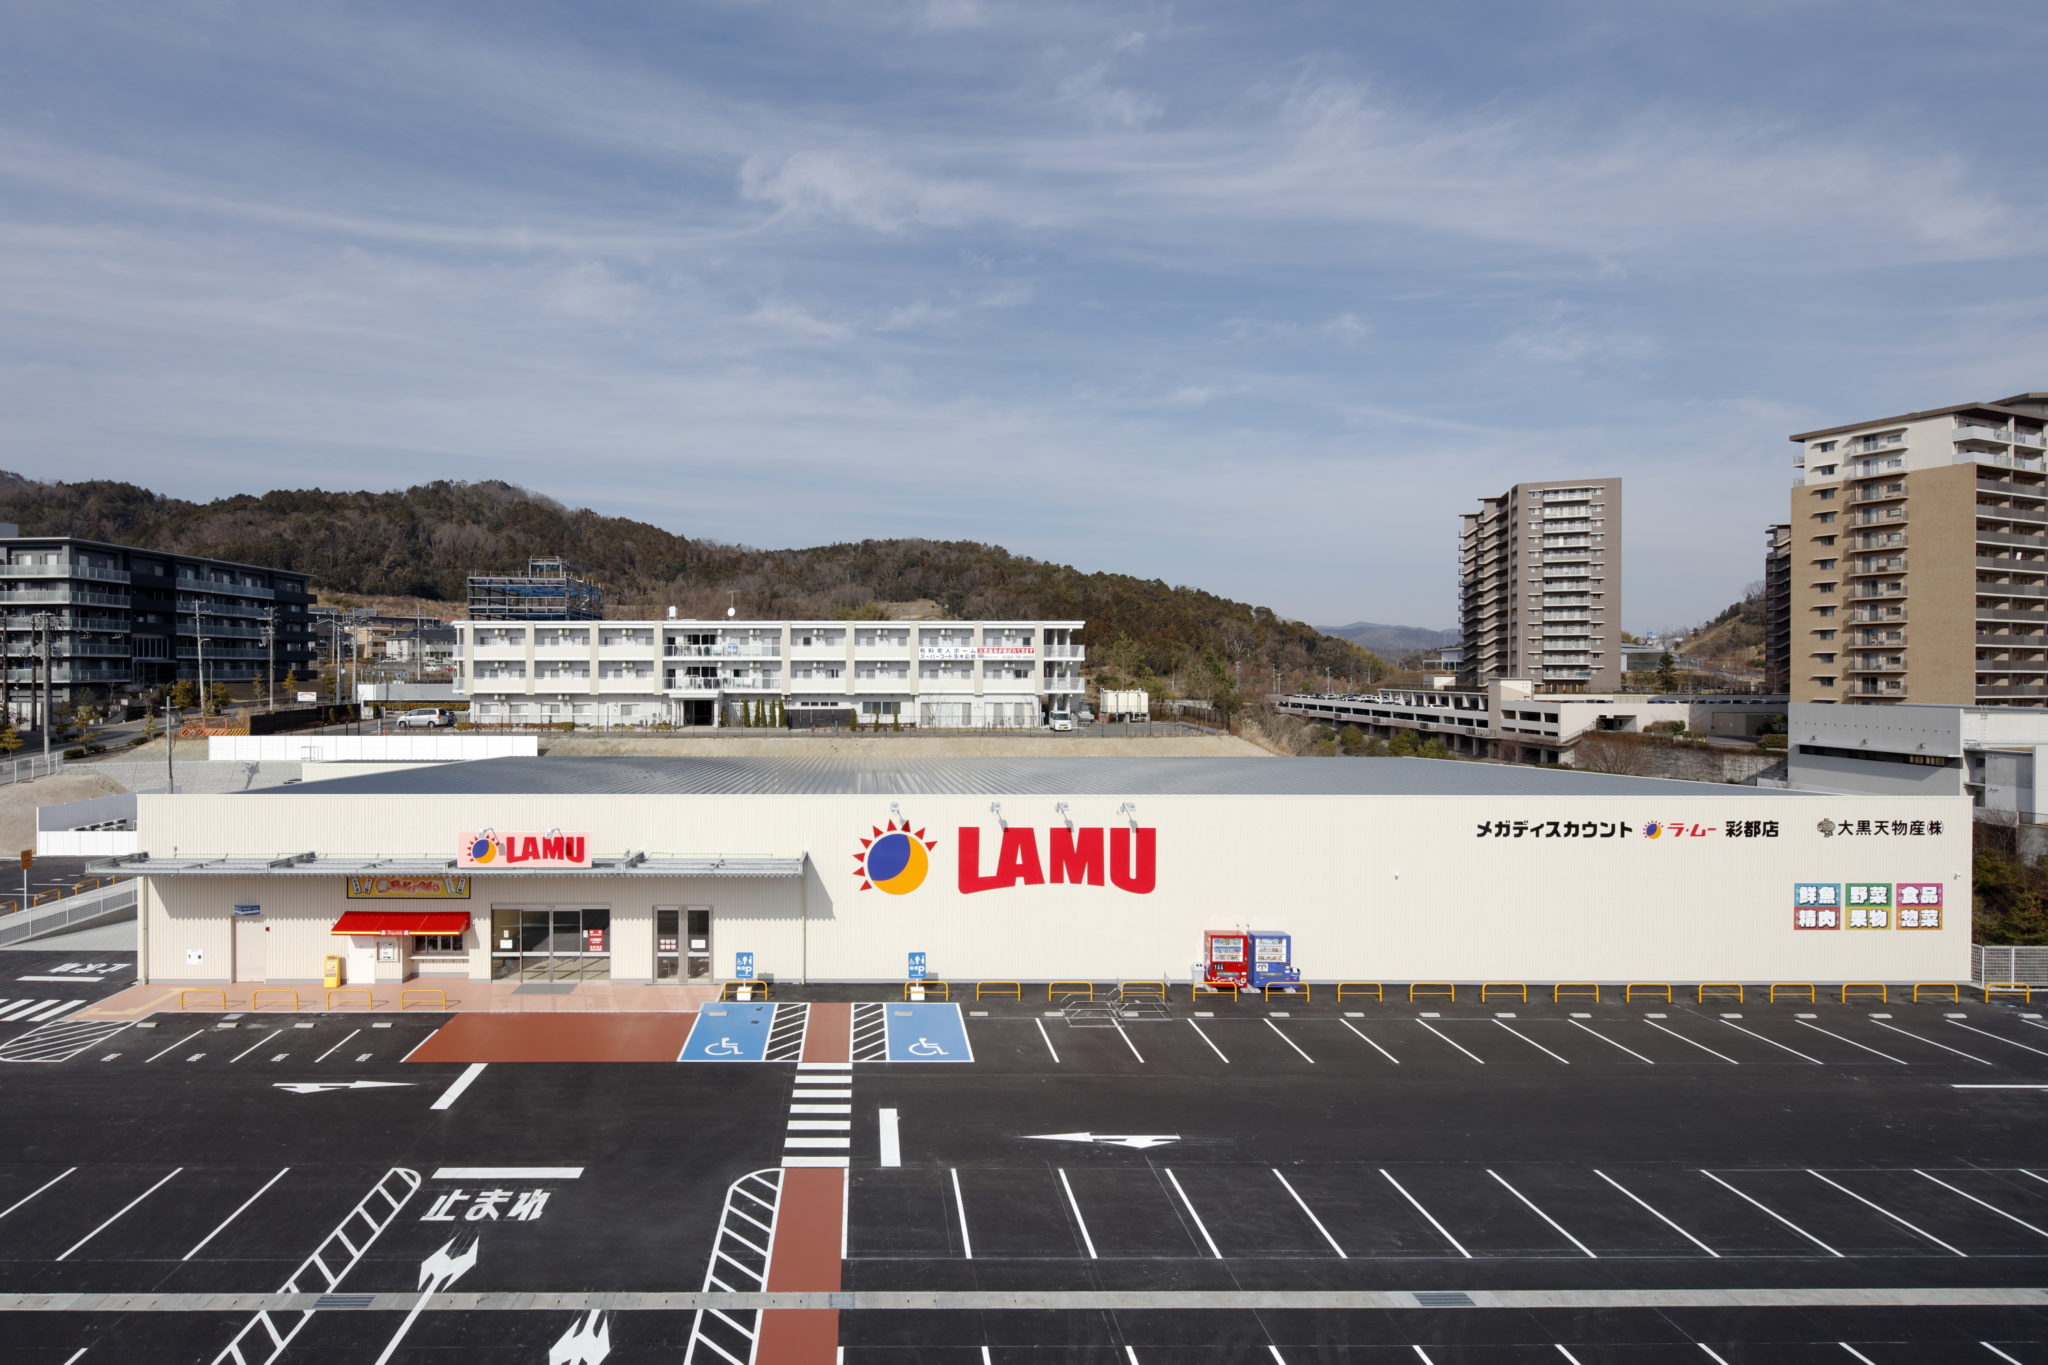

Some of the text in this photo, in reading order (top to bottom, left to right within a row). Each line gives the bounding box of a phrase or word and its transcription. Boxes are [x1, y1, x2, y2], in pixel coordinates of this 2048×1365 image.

[1476, 820, 1633, 838] メガディスカウント
[1725, 820, 1780, 838] 彩都店
[506, 836, 585, 863] LAMU
[958, 827, 1156, 894] LAMU
[1799, 886, 1837, 905] 鮮魚
[1850, 886, 1888, 905] 野菜
[1901, 886, 1939, 905] 食品
[1799, 909, 1837, 928] 精肉
[1850, 909, 1888, 928] 果物
[1901, 909, 1939, 928] 惣菜
[745, 966, 753, 975] P
[918, 966, 925, 975] P
[420, 1189, 551, 1221] 止まれ
